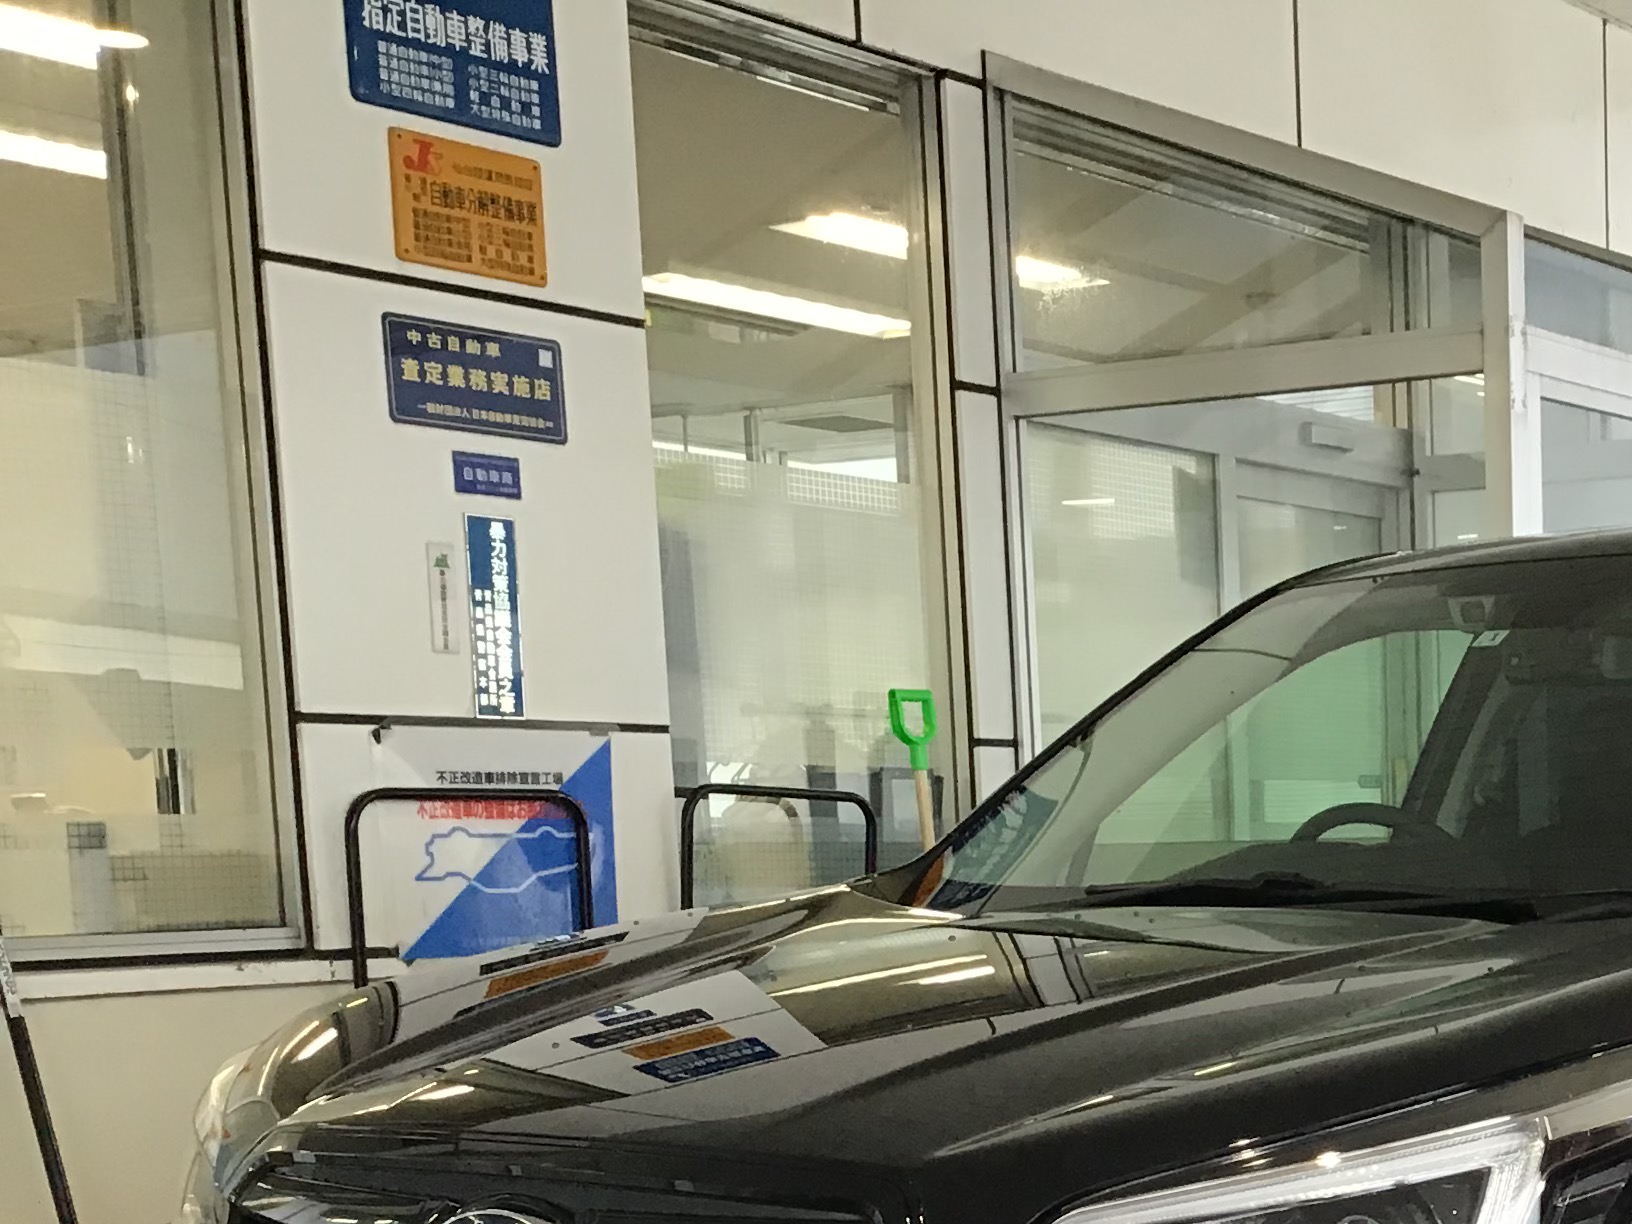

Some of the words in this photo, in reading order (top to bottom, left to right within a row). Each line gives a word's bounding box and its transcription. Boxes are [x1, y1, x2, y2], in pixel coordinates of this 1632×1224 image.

[362, 0, 550, 75] 指定自動車整備事業
[406, 329, 501, 357] 中古自動車
[401, 358, 552, 401] 査定業務実施店
[435, 770, 564, 785] 不正改造車排除宣言工場
